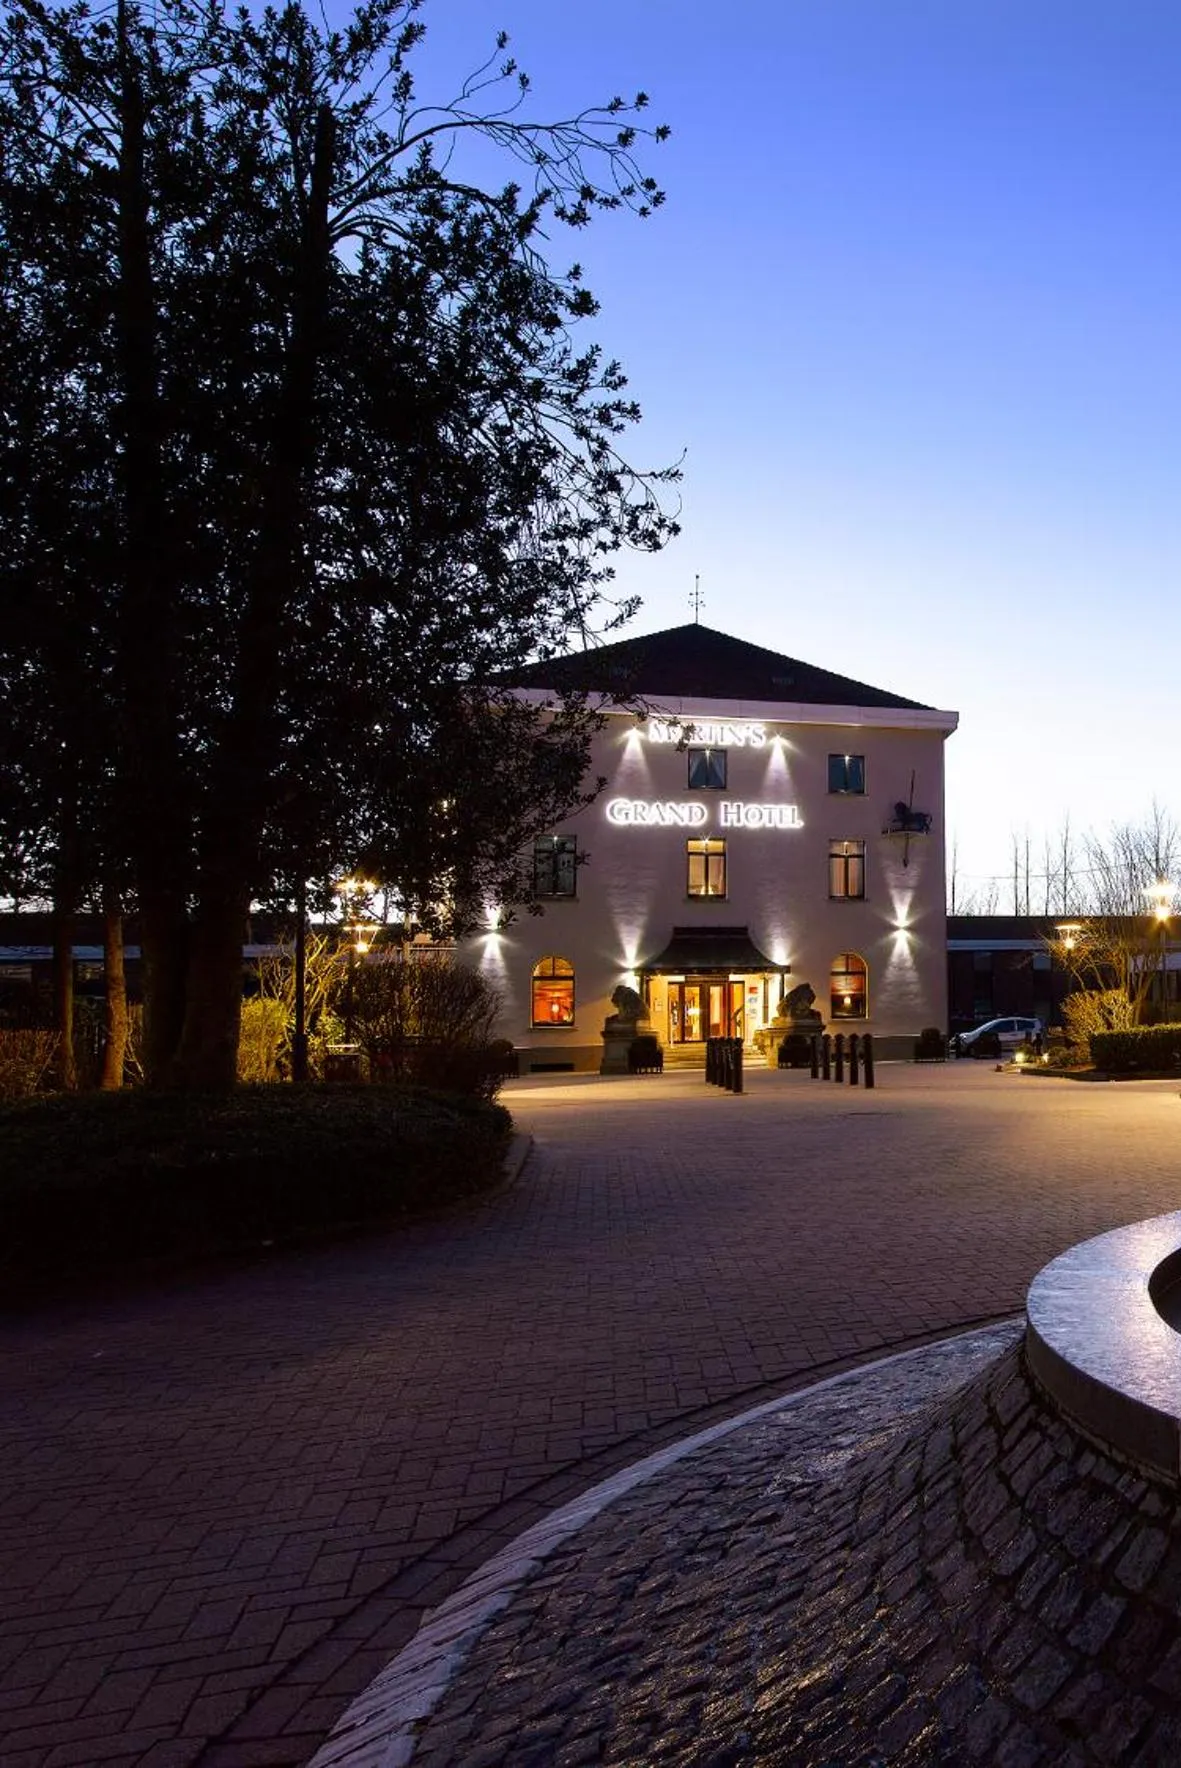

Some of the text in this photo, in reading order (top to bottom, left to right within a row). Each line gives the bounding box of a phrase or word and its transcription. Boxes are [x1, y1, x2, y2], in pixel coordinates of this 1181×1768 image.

[650, 721, 765, 746] MRTIN'S
[608, 799, 803, 827] GRAND HOTEL
